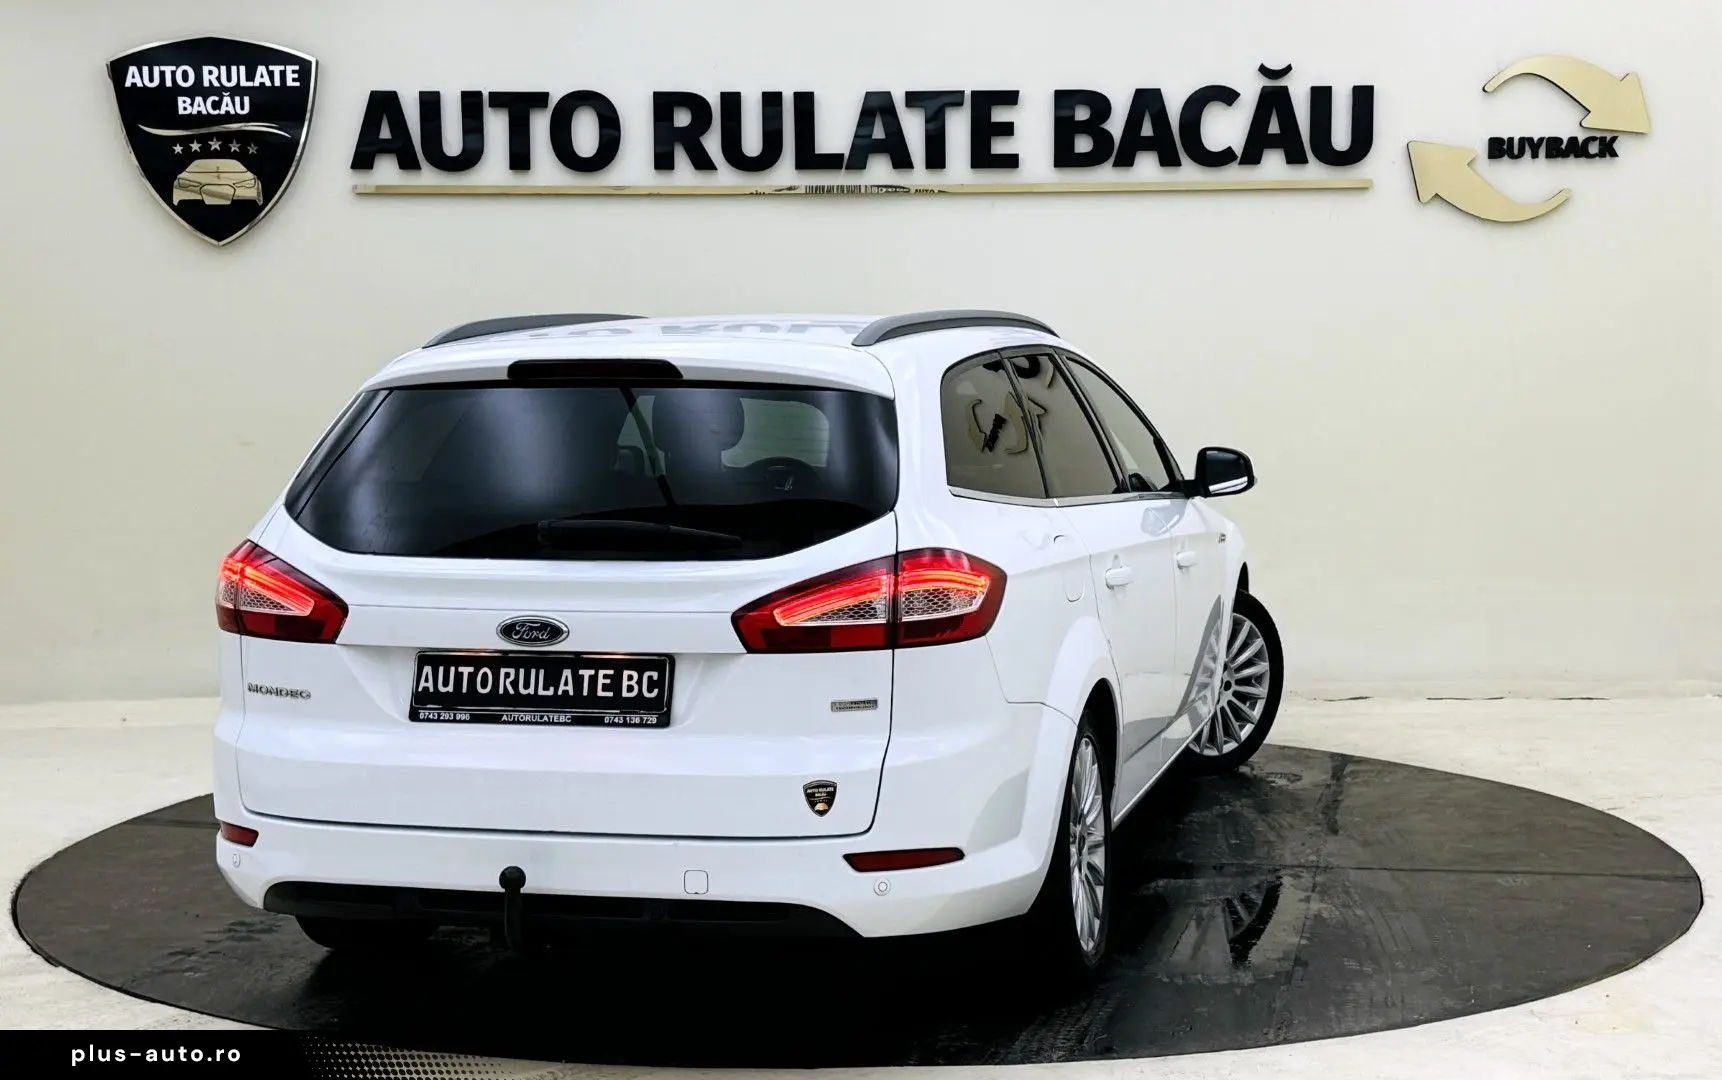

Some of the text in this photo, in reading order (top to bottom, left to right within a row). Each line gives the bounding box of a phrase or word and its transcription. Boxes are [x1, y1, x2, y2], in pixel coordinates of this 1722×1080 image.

[124, 65, 300, 88] AUTO RULATE
[177, 91, 251, 115] BACĂU
[350, 62, 1375, 173] AUTO RULATE BACĂU
[1487, 135, 1619, 160] BUYBACK
[512, 622, 551, 639] Ford
[247, 682, 312, 700] MONDEO
[418, 665, 659, 698] AUTO RULATE BC
[501, 714, 572, 723] AUTORULATEBC
